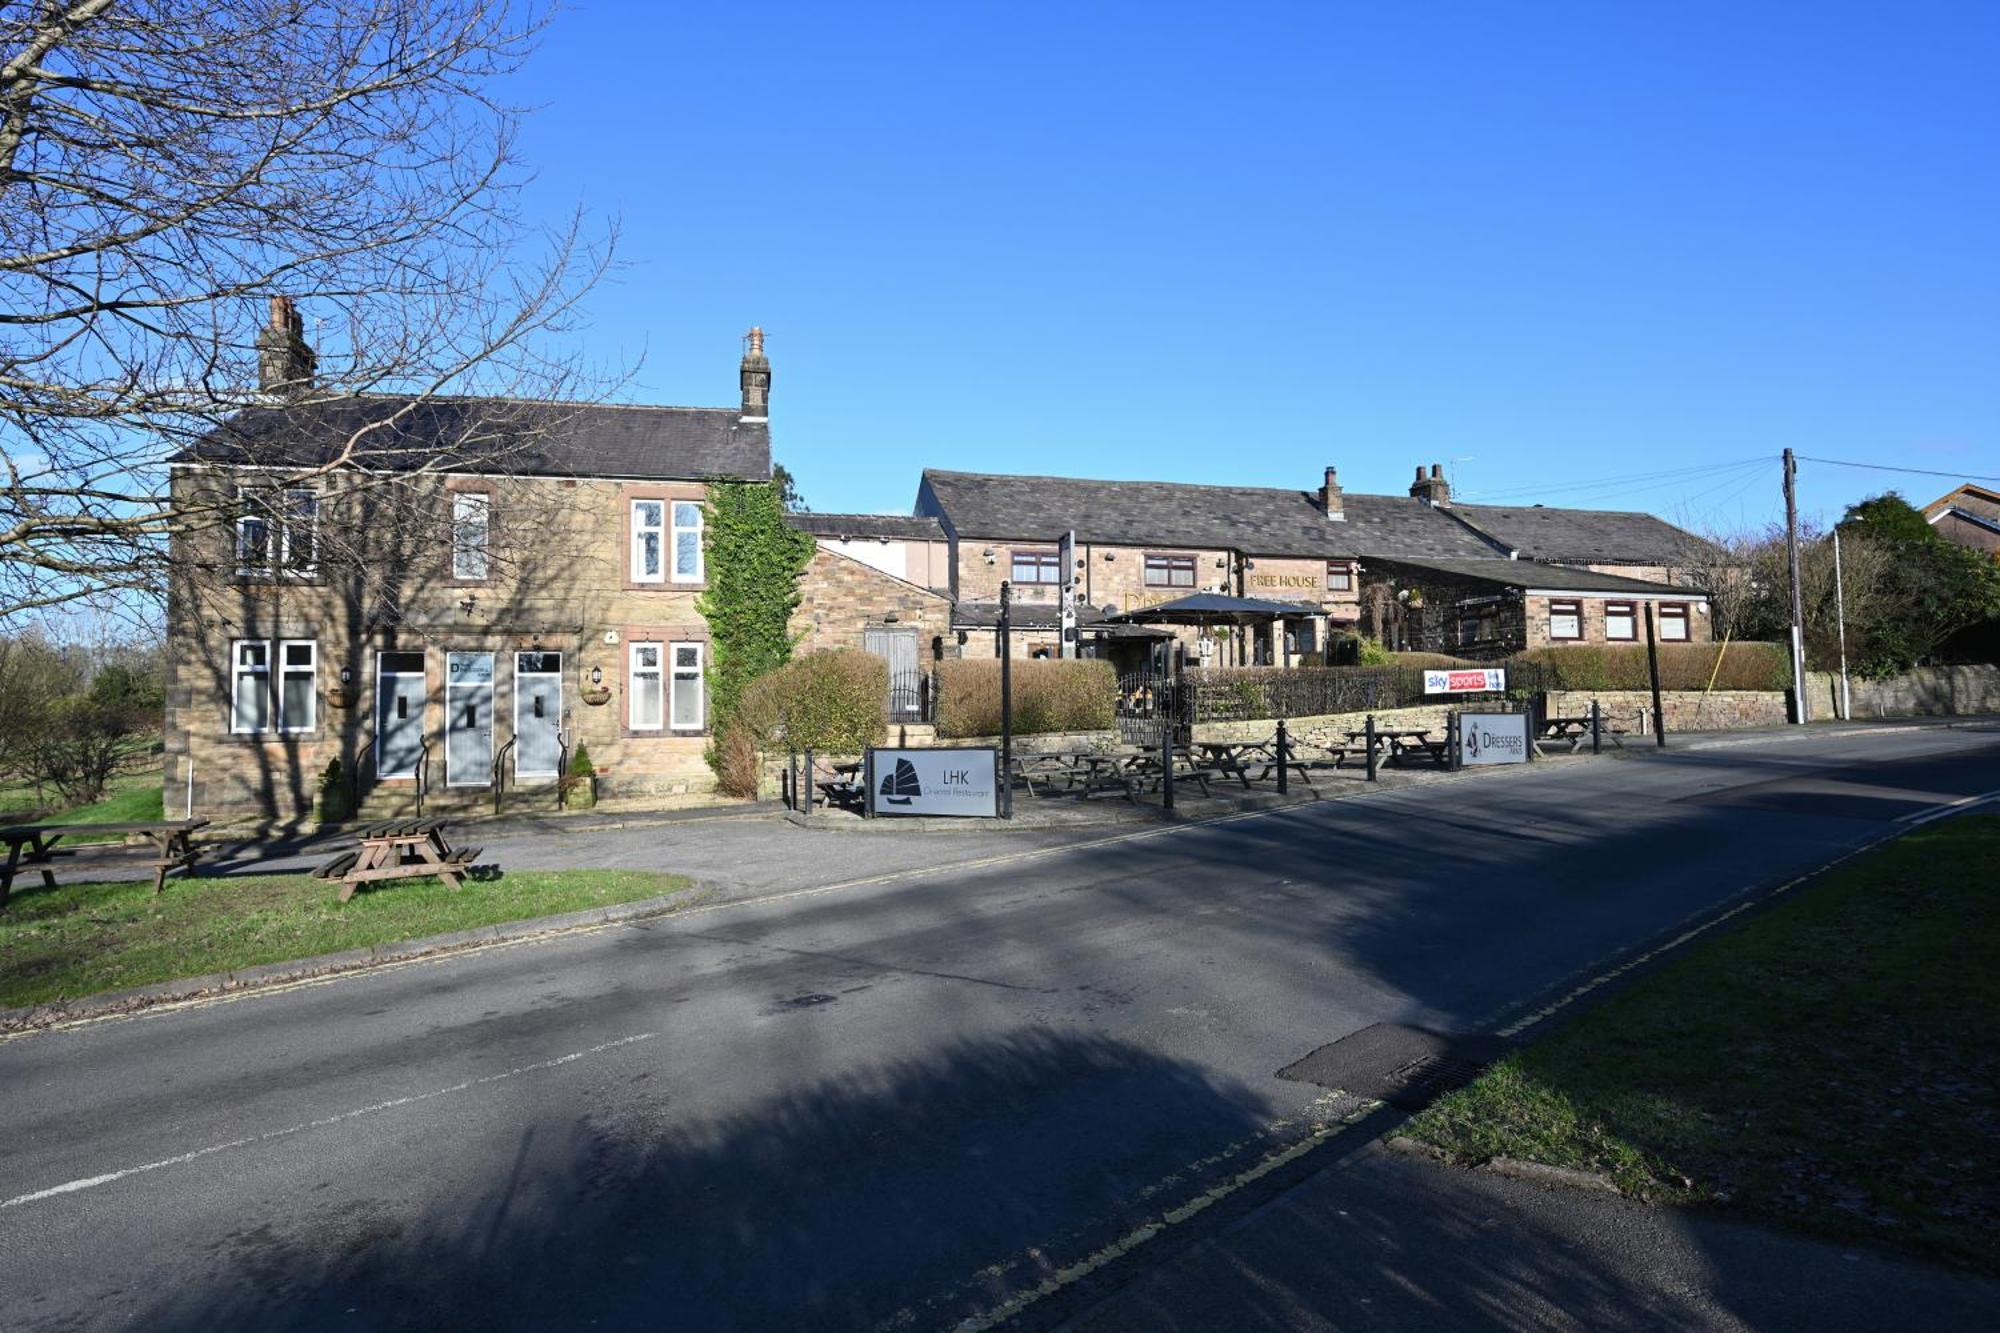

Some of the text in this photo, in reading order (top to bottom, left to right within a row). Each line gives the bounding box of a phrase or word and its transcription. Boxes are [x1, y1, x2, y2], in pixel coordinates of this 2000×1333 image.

[1250, 575, 1319, 588] FREE HOUSE
[1428, 674, 1447, 689] sky
[1450, 673, 1485, 689] sports
[943, 769, 969, 785] LHK
